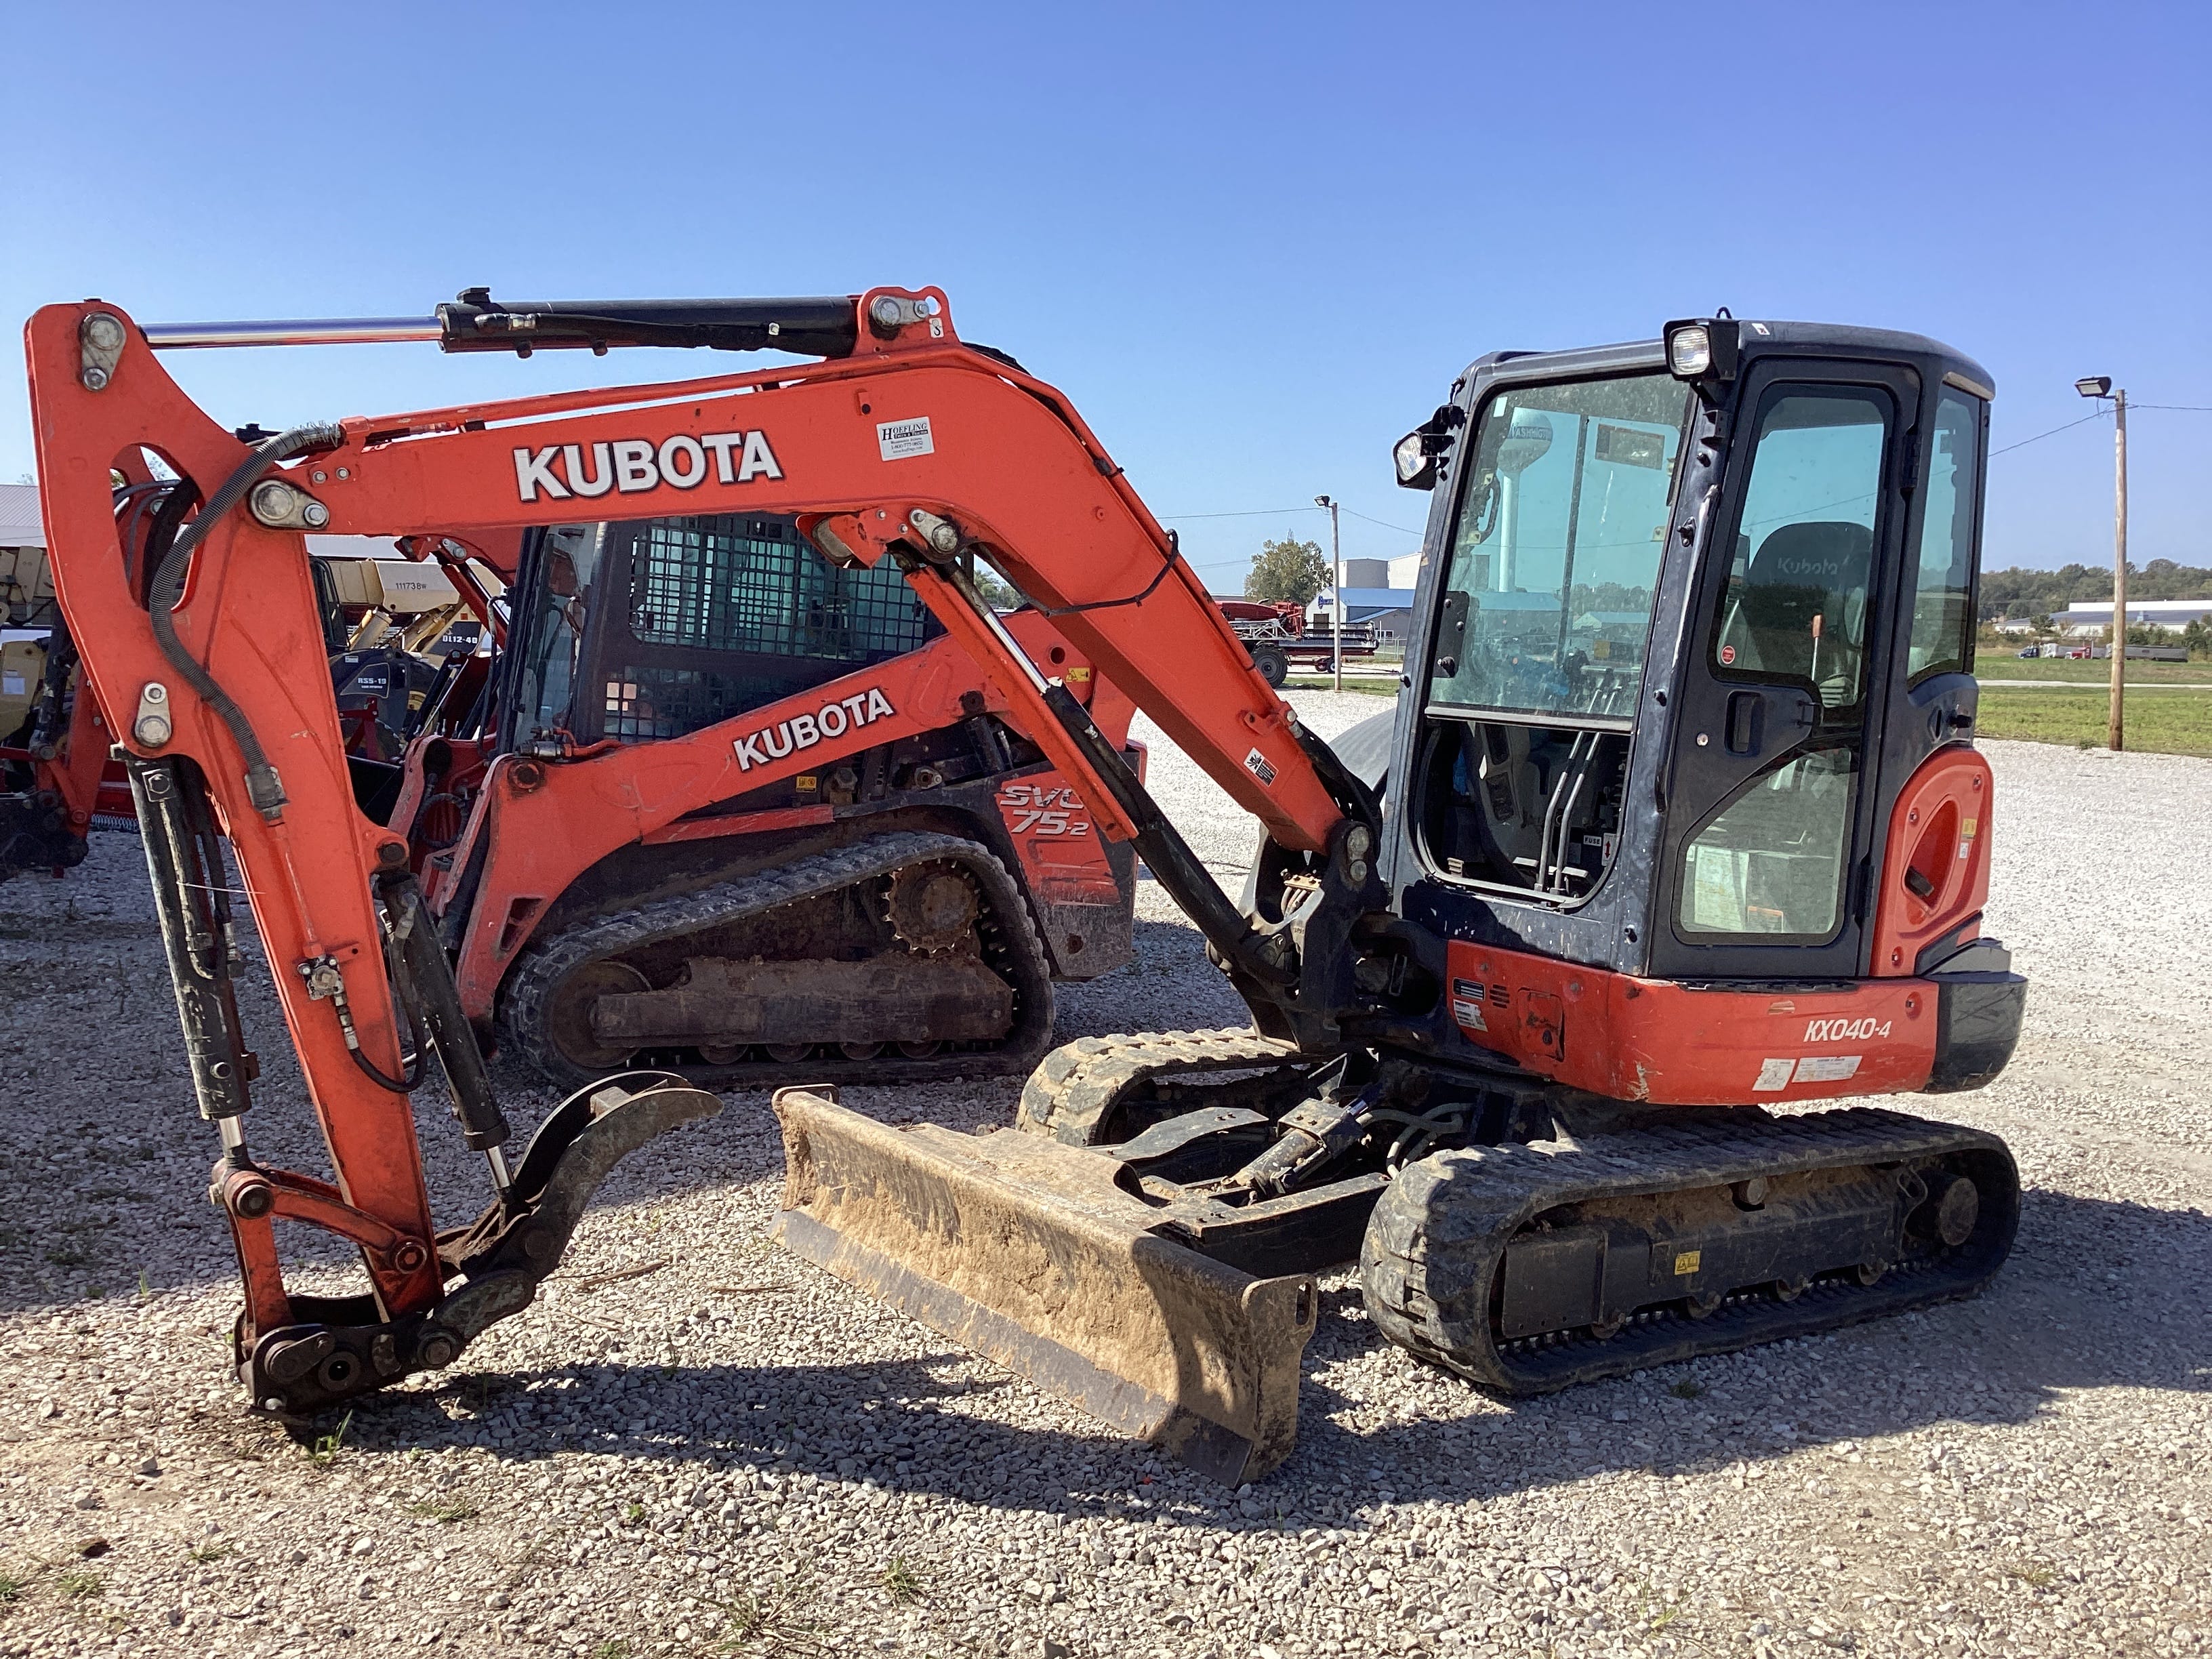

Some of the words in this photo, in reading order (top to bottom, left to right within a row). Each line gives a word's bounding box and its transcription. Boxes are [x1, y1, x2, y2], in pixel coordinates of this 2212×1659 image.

[882, 423, 927, 441] HOEFLING
[513, 430, 783, 501] KUBOTA
[1778, 557, 1838, 575] Kubota
[733, 688, 895, 772] KUBOTA
[1010, 809, 1090, 836] 75-2
[1803, 1017, 1892, 1042] KX040-4
